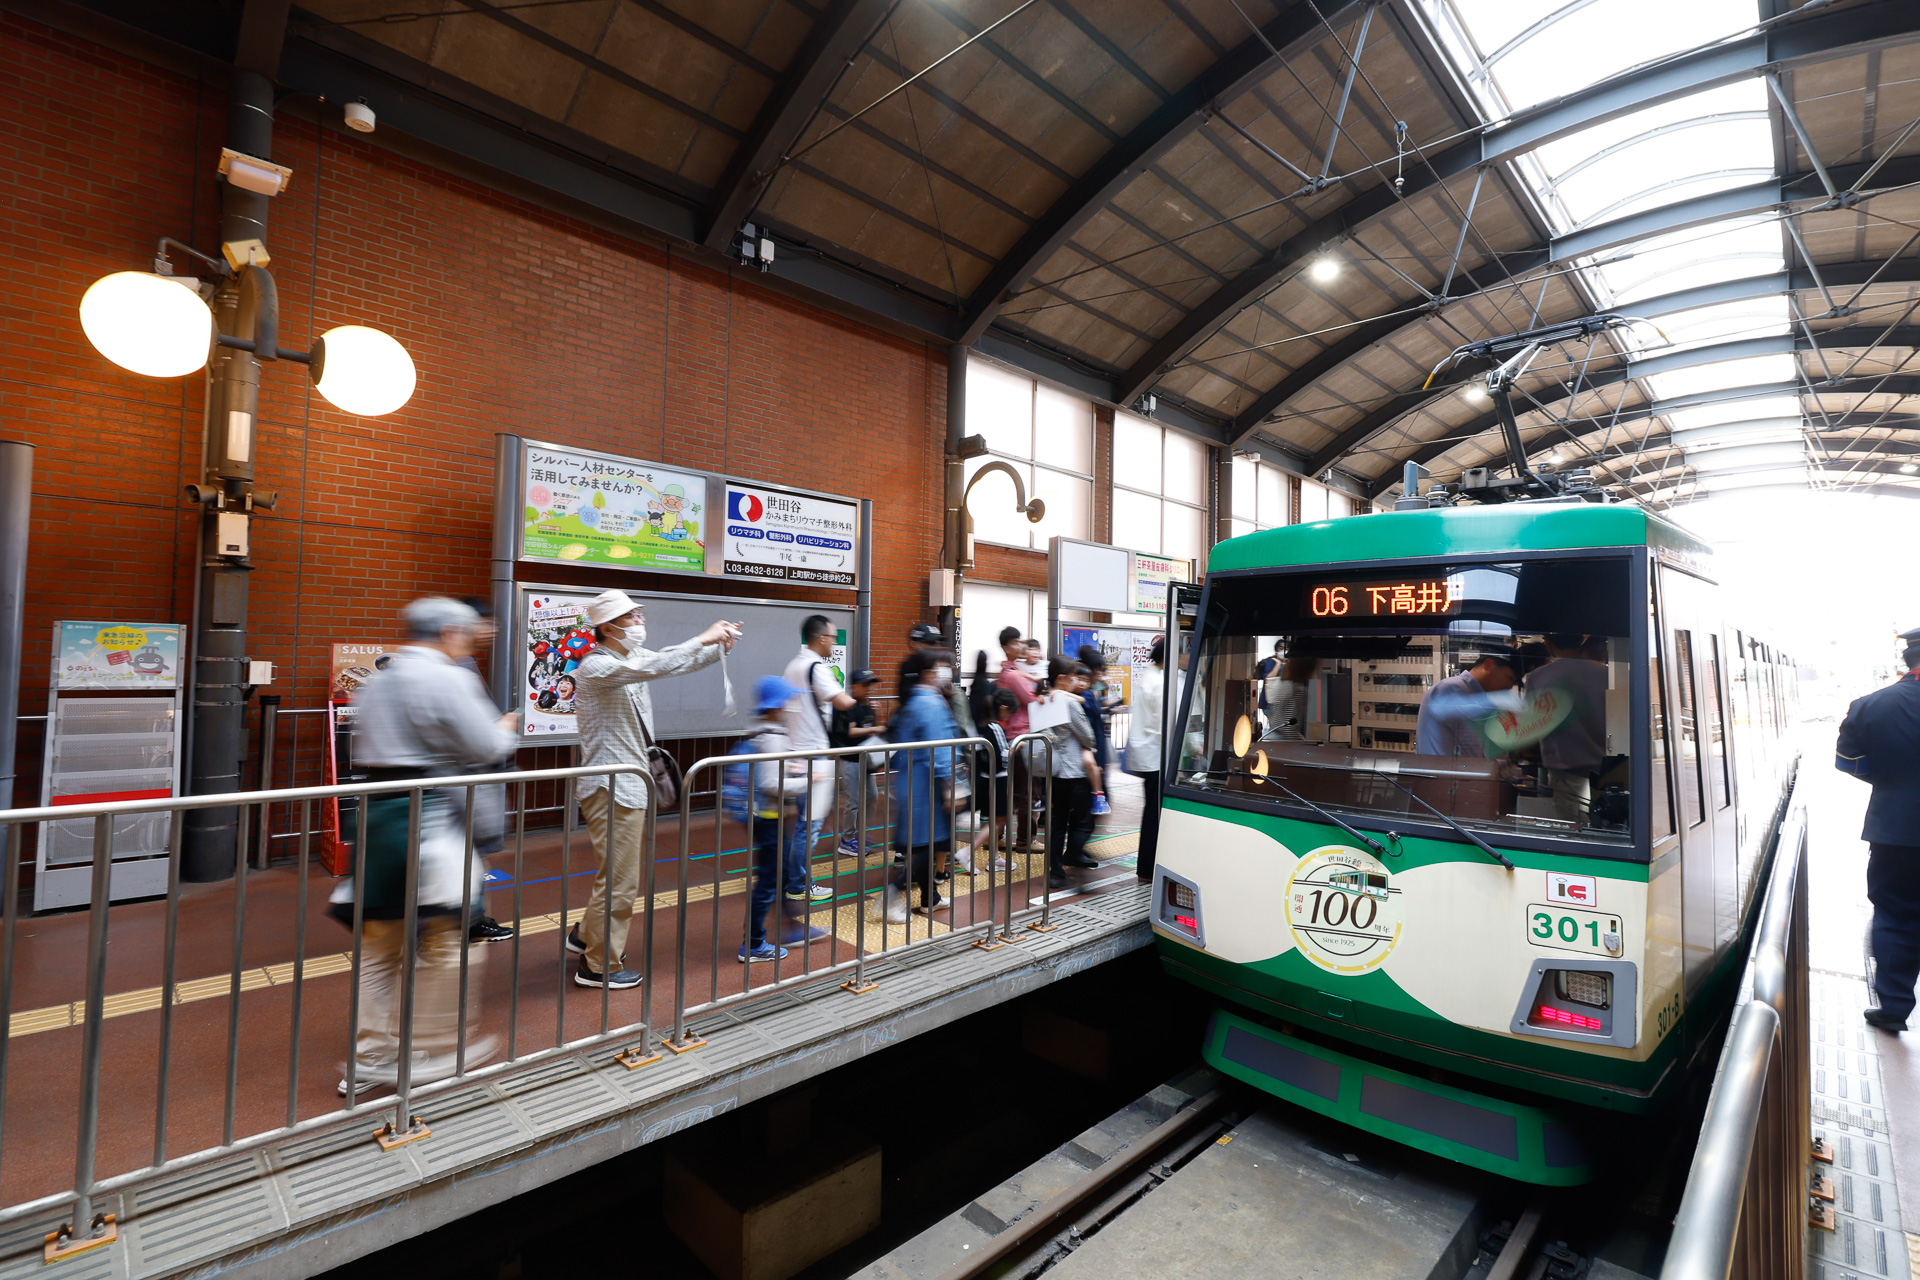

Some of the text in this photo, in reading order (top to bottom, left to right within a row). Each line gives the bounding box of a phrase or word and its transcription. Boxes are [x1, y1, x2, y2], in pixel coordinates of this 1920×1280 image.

[531, 453, 654, 483] シルバー人材センターを
[530, 468, 643, 496] 活用してみませんか?
[553, 497, 572, 505] シニア
[767, 496, 801, 514] 世田谷
[765, 510, 853, 532] かみまちリウマチ整形外科
[731, 528, 762, 538] リウマチ科
[768, 531, 792, 543] 整形外科
[798, 536, 850, 550] リハビリテーション科
[731, 564, 784, 576] 03-6432-6126
[1312, 581, 1465, 616] 06 下高井戸
[342, 646, 383, 654] SALUS
[1132, 645, 1151, 655] サッカー
[1328, 855, 1362, 868] 世田谷線
[1309, 889, 1378, 929] 100
[1532, 912, 1599, 947] 301
[1322, 937, 1356, 947] since 1925
[1657, 992, 1680, 1039] 301-B
